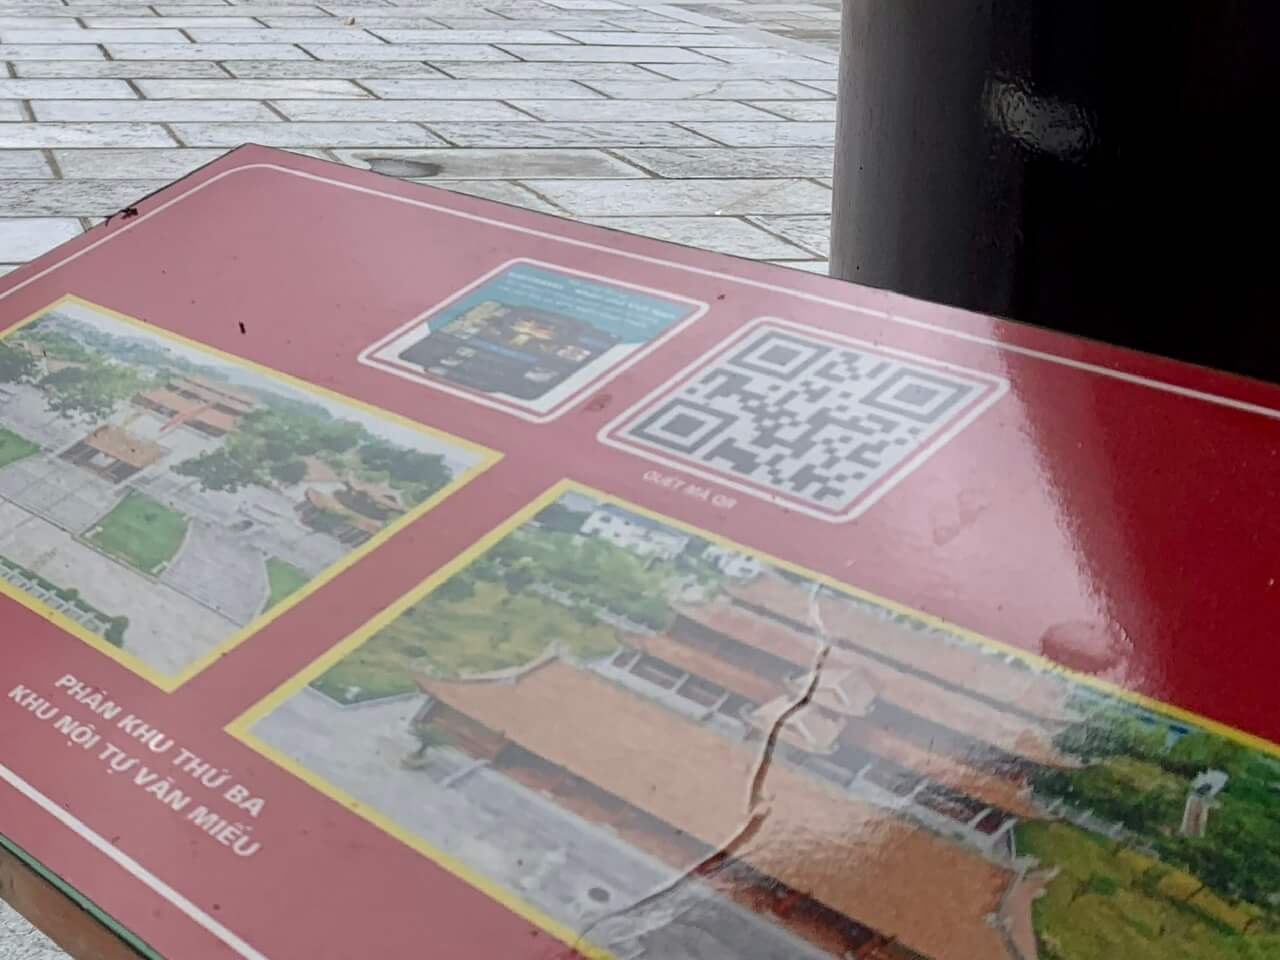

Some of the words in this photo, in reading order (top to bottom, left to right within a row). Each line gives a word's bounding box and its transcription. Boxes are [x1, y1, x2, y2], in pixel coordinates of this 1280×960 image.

[8, 684, 58, 720] KHU
[54, 715, 101, 749] NỘI
[99, 742, 140, 774] TỰ
[188, 805, 260, 857] MIẾU
[117, 714, 174, 753] KHU
[172, 747, 231, 788] THỨ
[224, 784, 265, 817] BA
